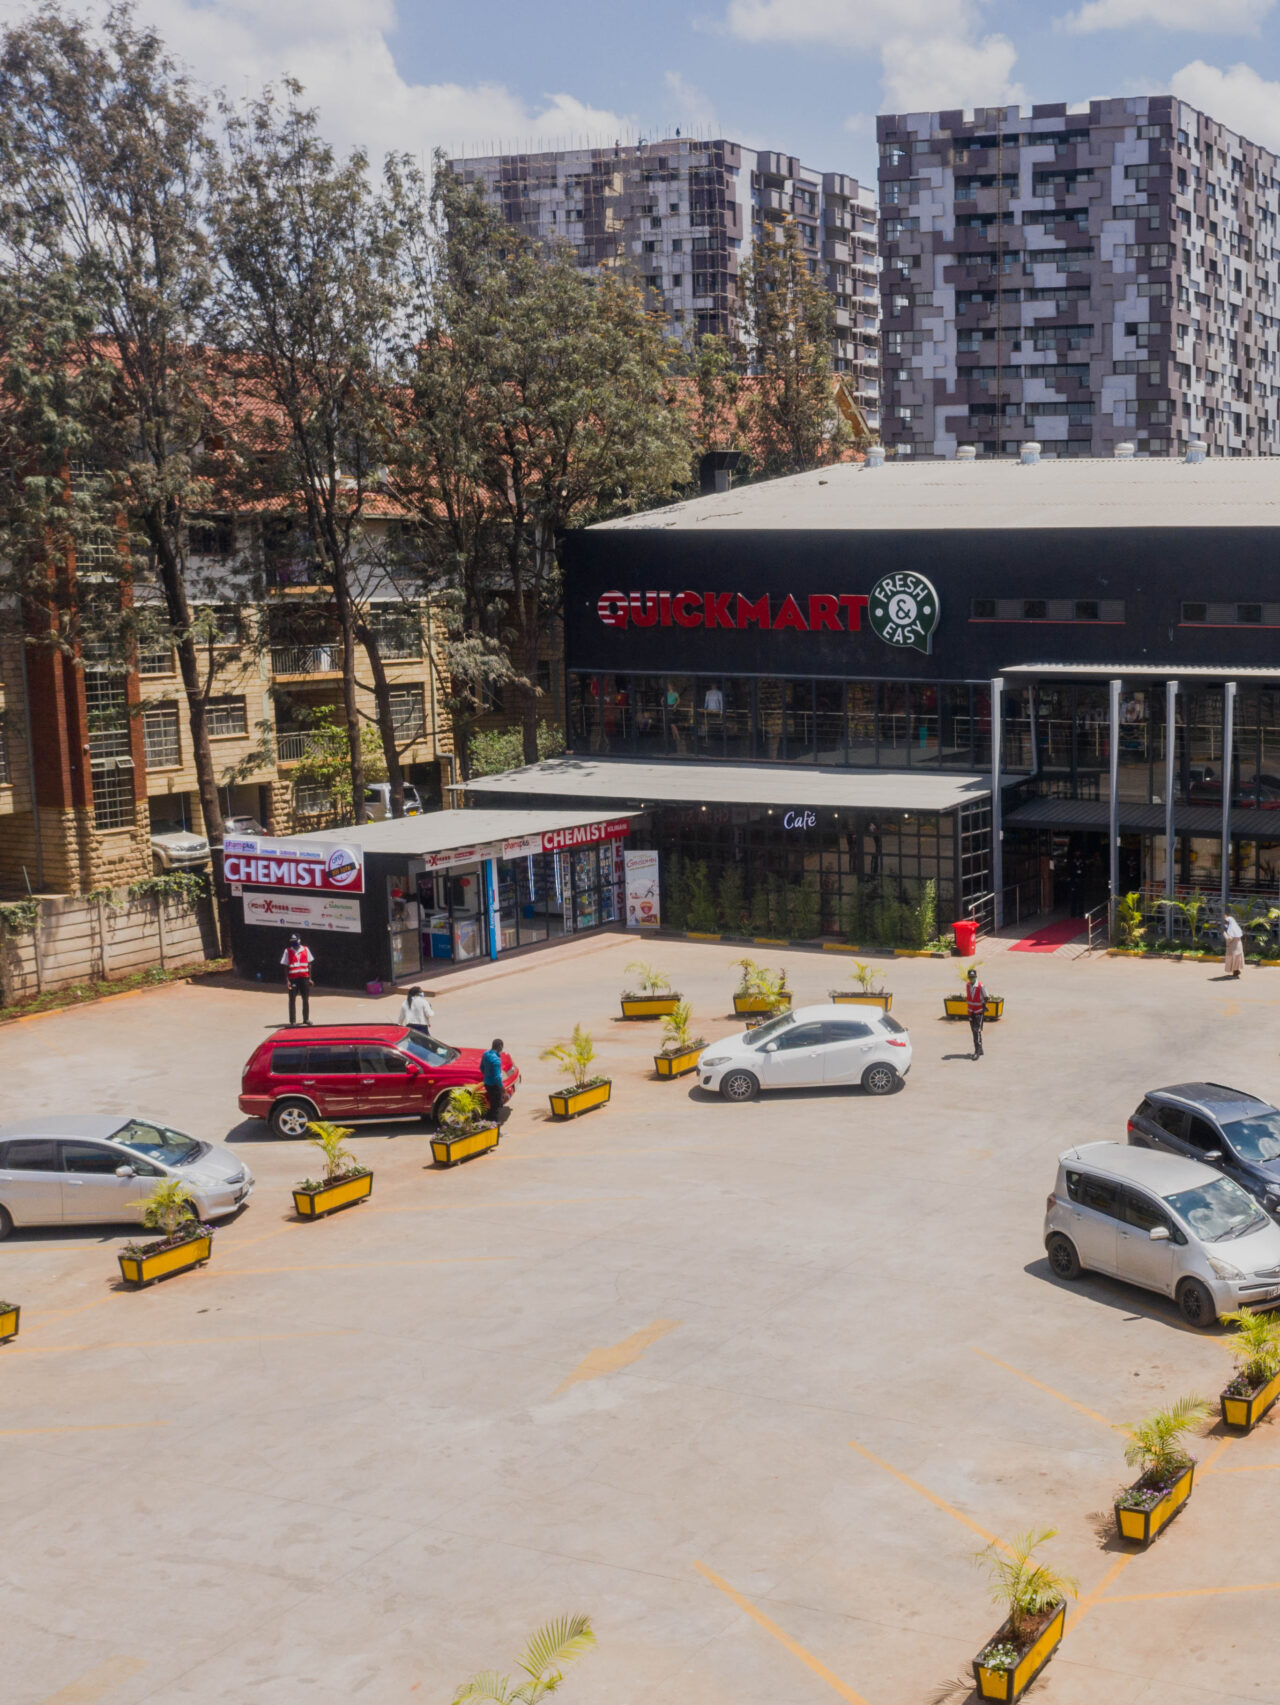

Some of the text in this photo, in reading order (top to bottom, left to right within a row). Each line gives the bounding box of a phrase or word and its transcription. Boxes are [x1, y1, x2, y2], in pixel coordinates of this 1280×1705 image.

[875, 574, 929, 602] FRESH
[597, 590, 869, 632] QUICKMART
[895, 599, 912, 620] &
[882, 621, 926, 644] EASY
[784, 810, 817, 831] Café
[543, 823, 607, 849] CHEMIST
[224, 857, 326, 887] CHEMIST
